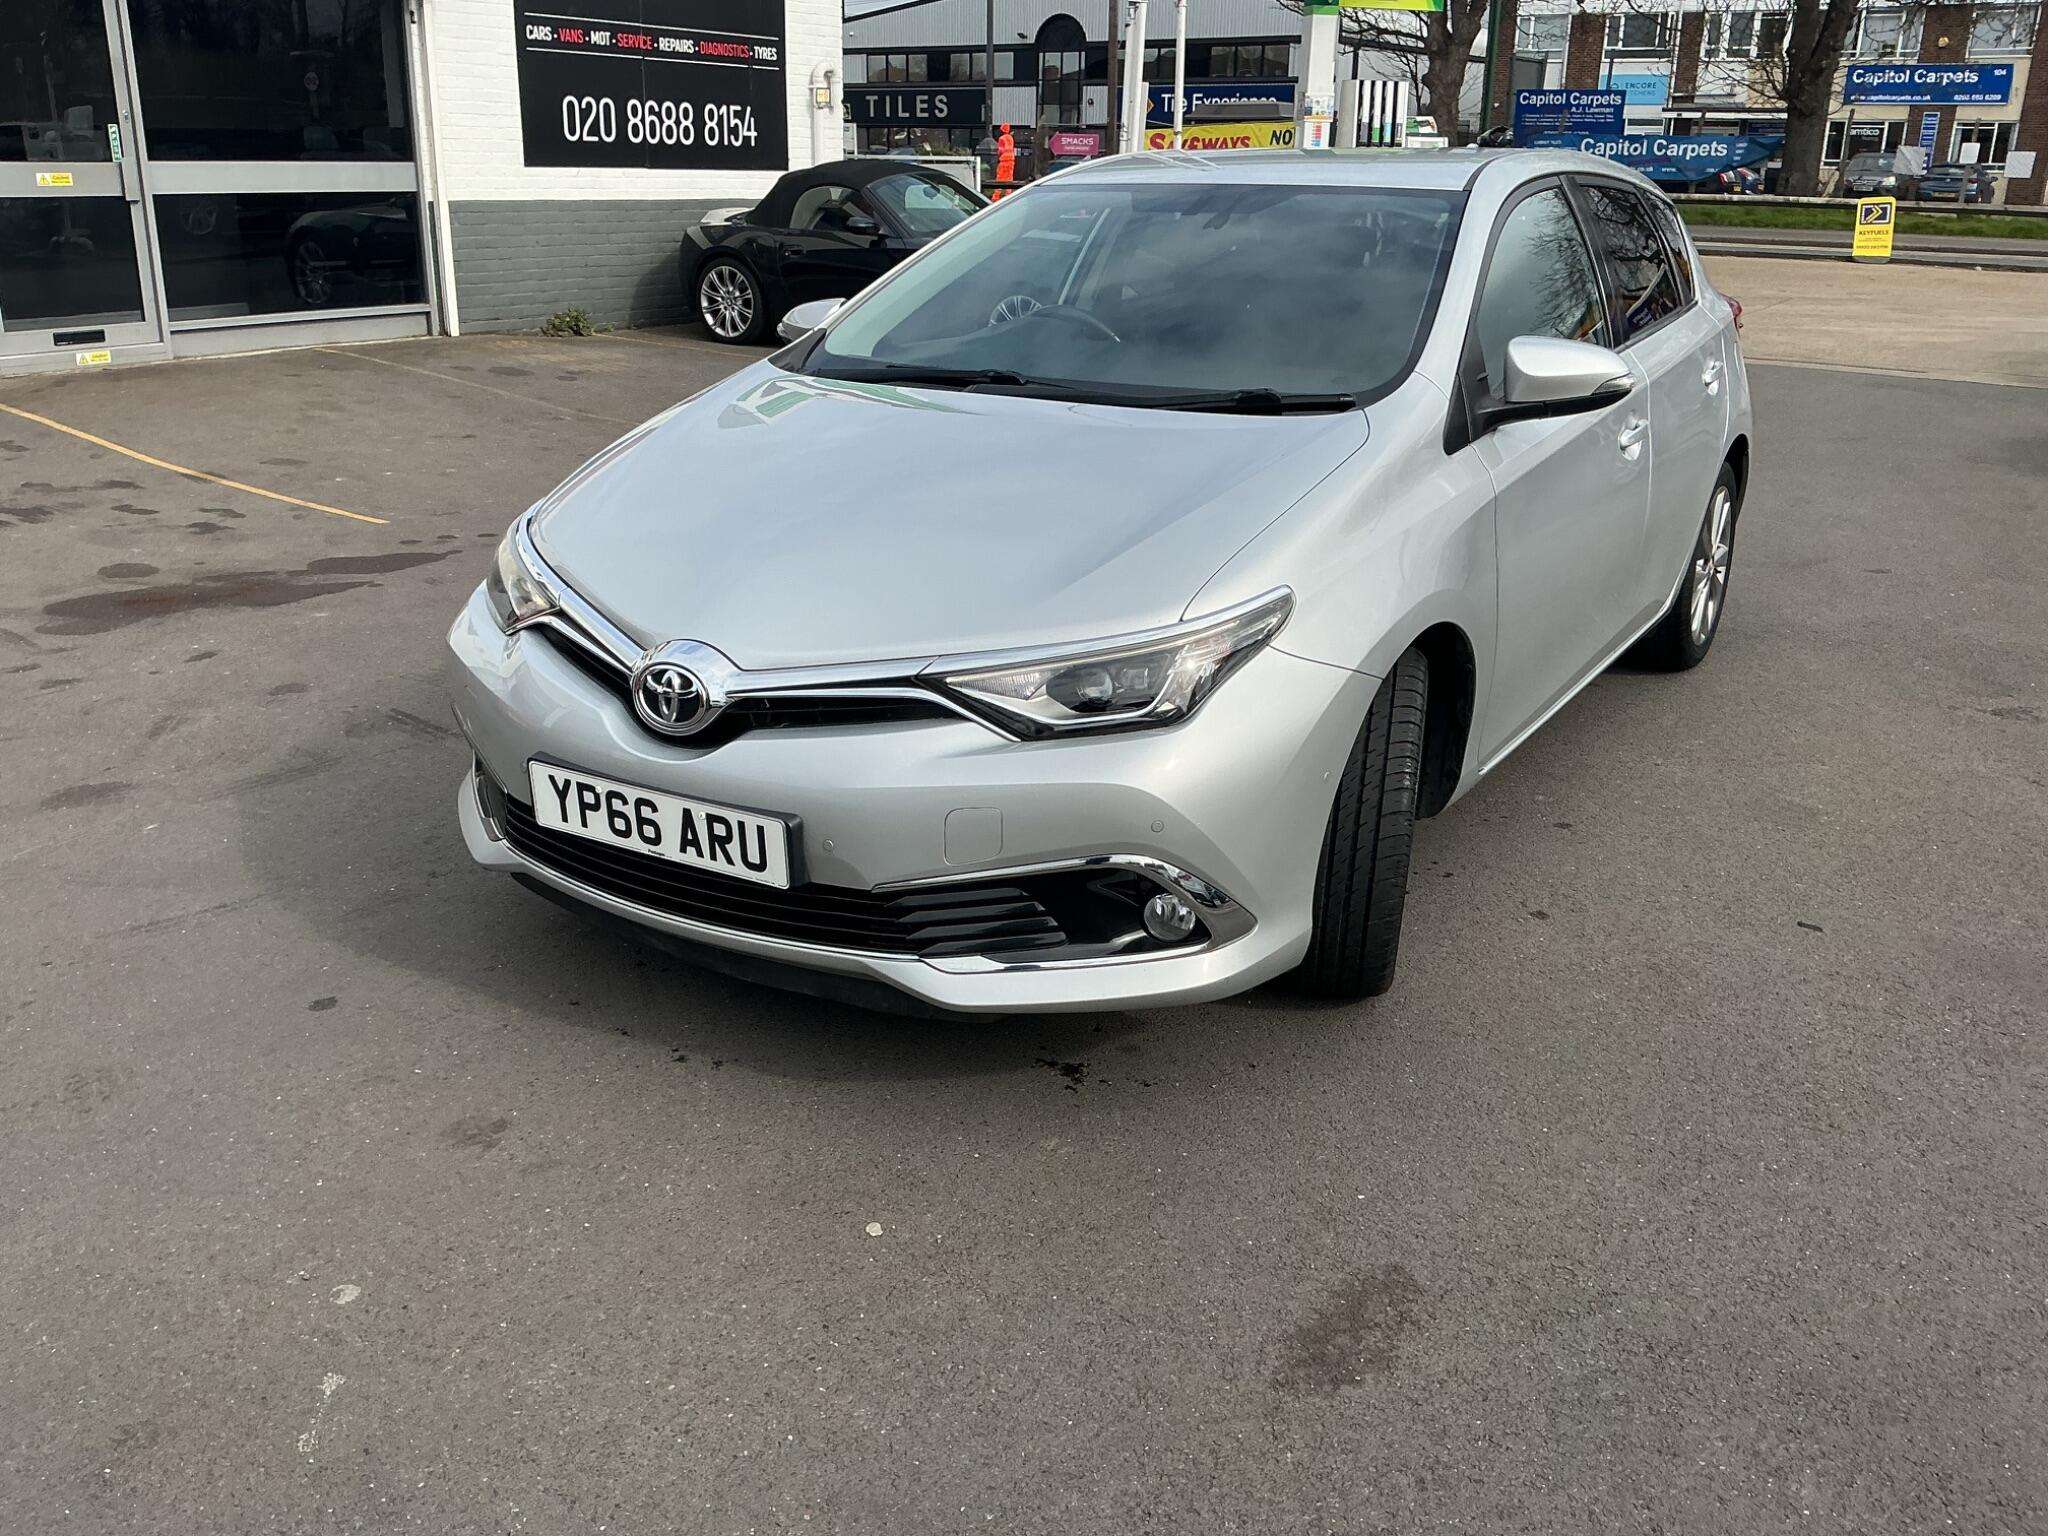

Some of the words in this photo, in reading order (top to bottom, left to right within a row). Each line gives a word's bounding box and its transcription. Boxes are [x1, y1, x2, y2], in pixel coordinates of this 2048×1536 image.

[525, 24, 553, 41] CARS
[558, 28, 584, 44] VANS
[590, 31, 611, 46] MOT
[616, 33, 653, 50] SERVICE
[658, 37, 695, 54] REPAIRS
[699, 41, 750, 58] DIAGNOSTICS
[753, 45, 778, 61] TYRES
[1625, 81, 1657, 90] ENCORE
[1852, 69, 1910, 86] Capitol
[1913, 69, 1980, 86] Carpets
[865, 94, 949, 118] TILES
[1161, 93, 1188, 112] Tie
[1519, 92, 1567, 107] Capitol
[1570, 92, 1622, 108] Carpets
[561, 95, 617, 143] 020
[626, 98, 695, 146] 8688
[703, 103, 758, 148] 8154
[1060, 137, 1094, 145] SMACKS
[1580, 138, 1647, 159] Capitol
[1653, 139, 1728, 161] Carpets
[548, 774, 662, 847] YP66
[679, 807, 768, 873] ARU
